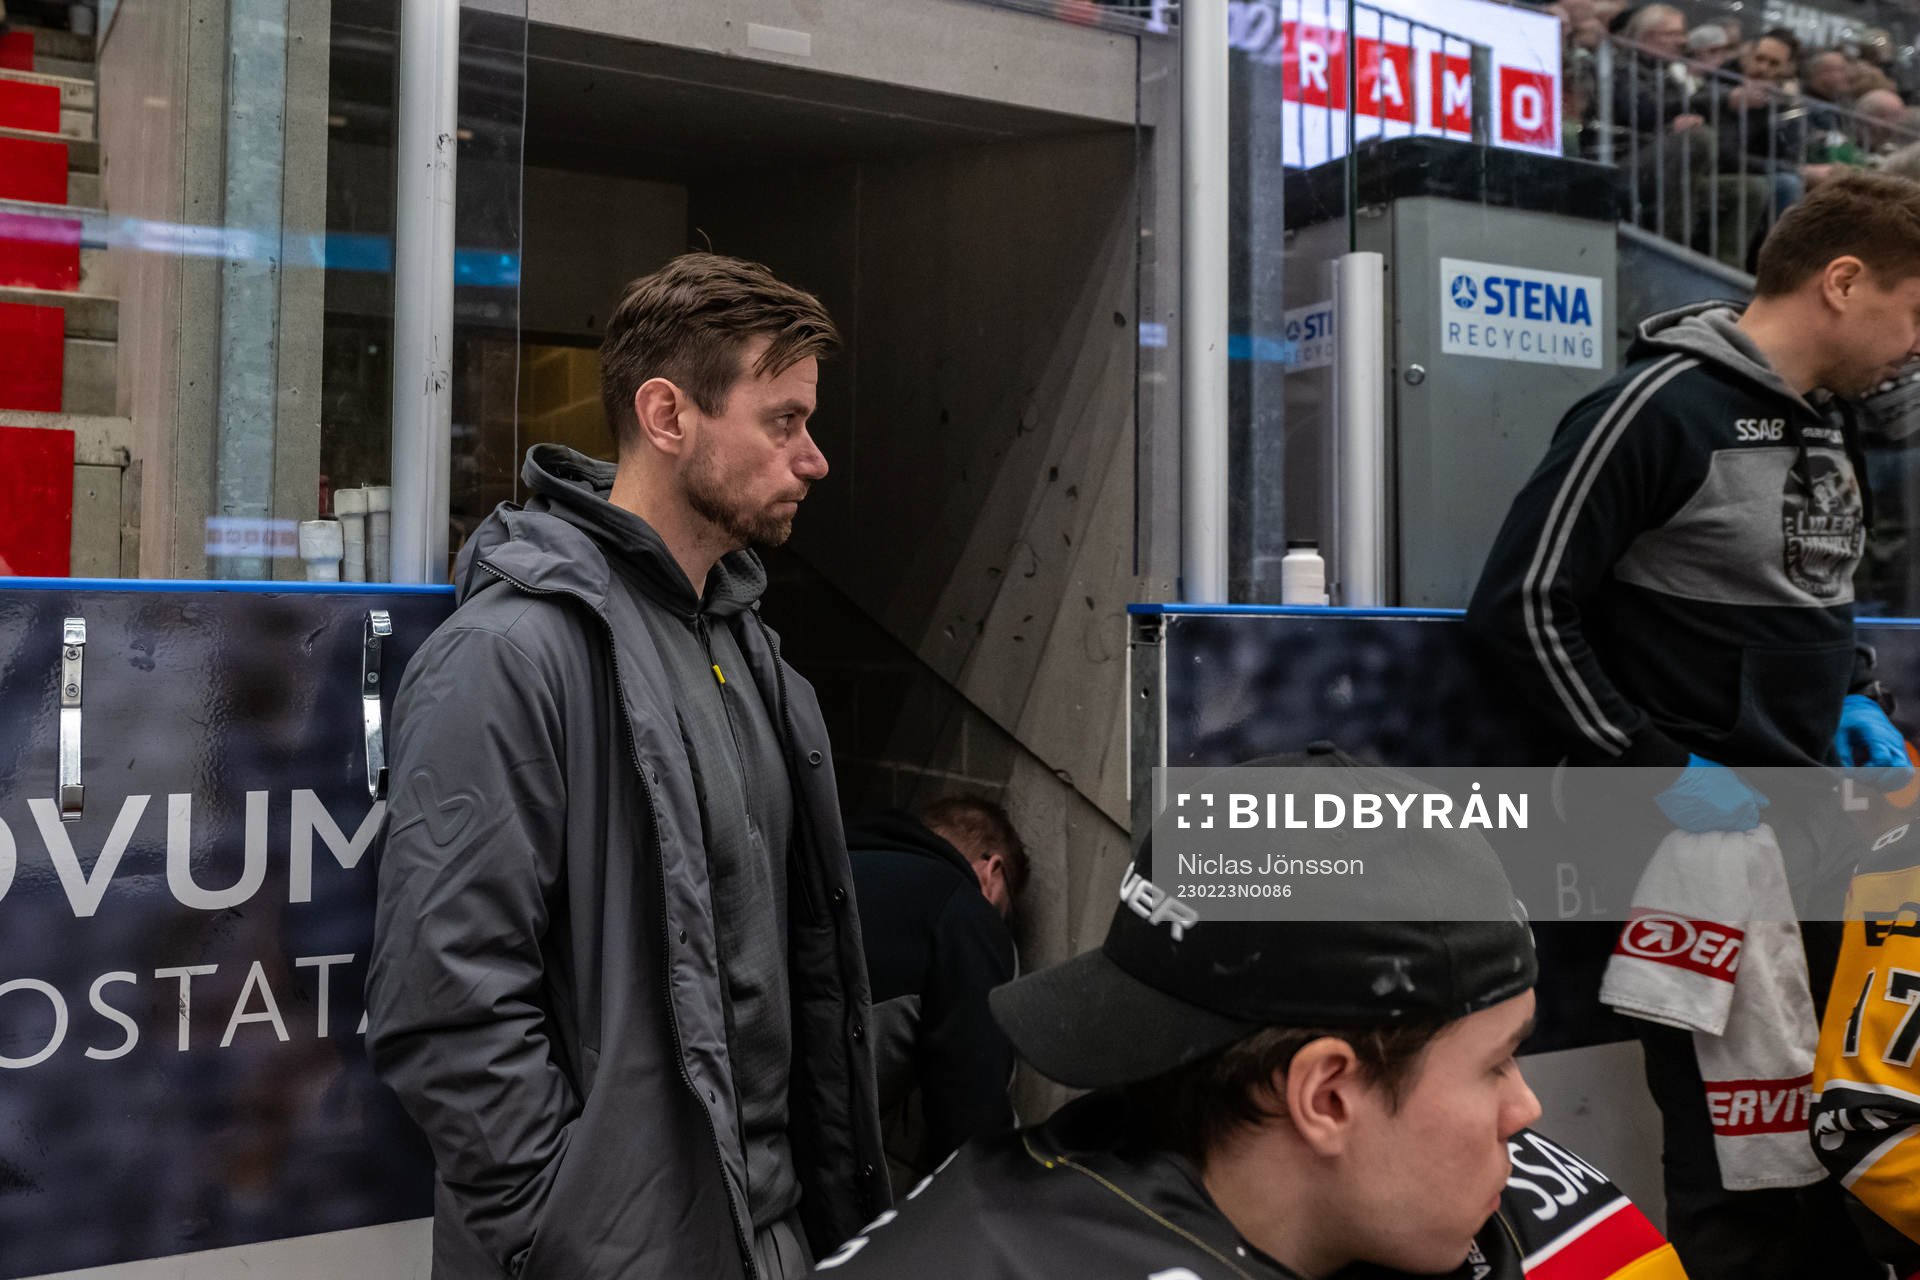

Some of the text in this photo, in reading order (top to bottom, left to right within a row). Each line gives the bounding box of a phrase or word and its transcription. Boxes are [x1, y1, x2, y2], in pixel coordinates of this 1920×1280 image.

[1484, 276, 1592, 327] STENA
[1448, 322, 1593, 358] RECYCLING
[1735, 418, 1785, 442] SSAB
[0, 789, 387, 918] VUM
[0, 953, 368, 1069] OSTAT
[1842, 966, 1920, 1068] 17
